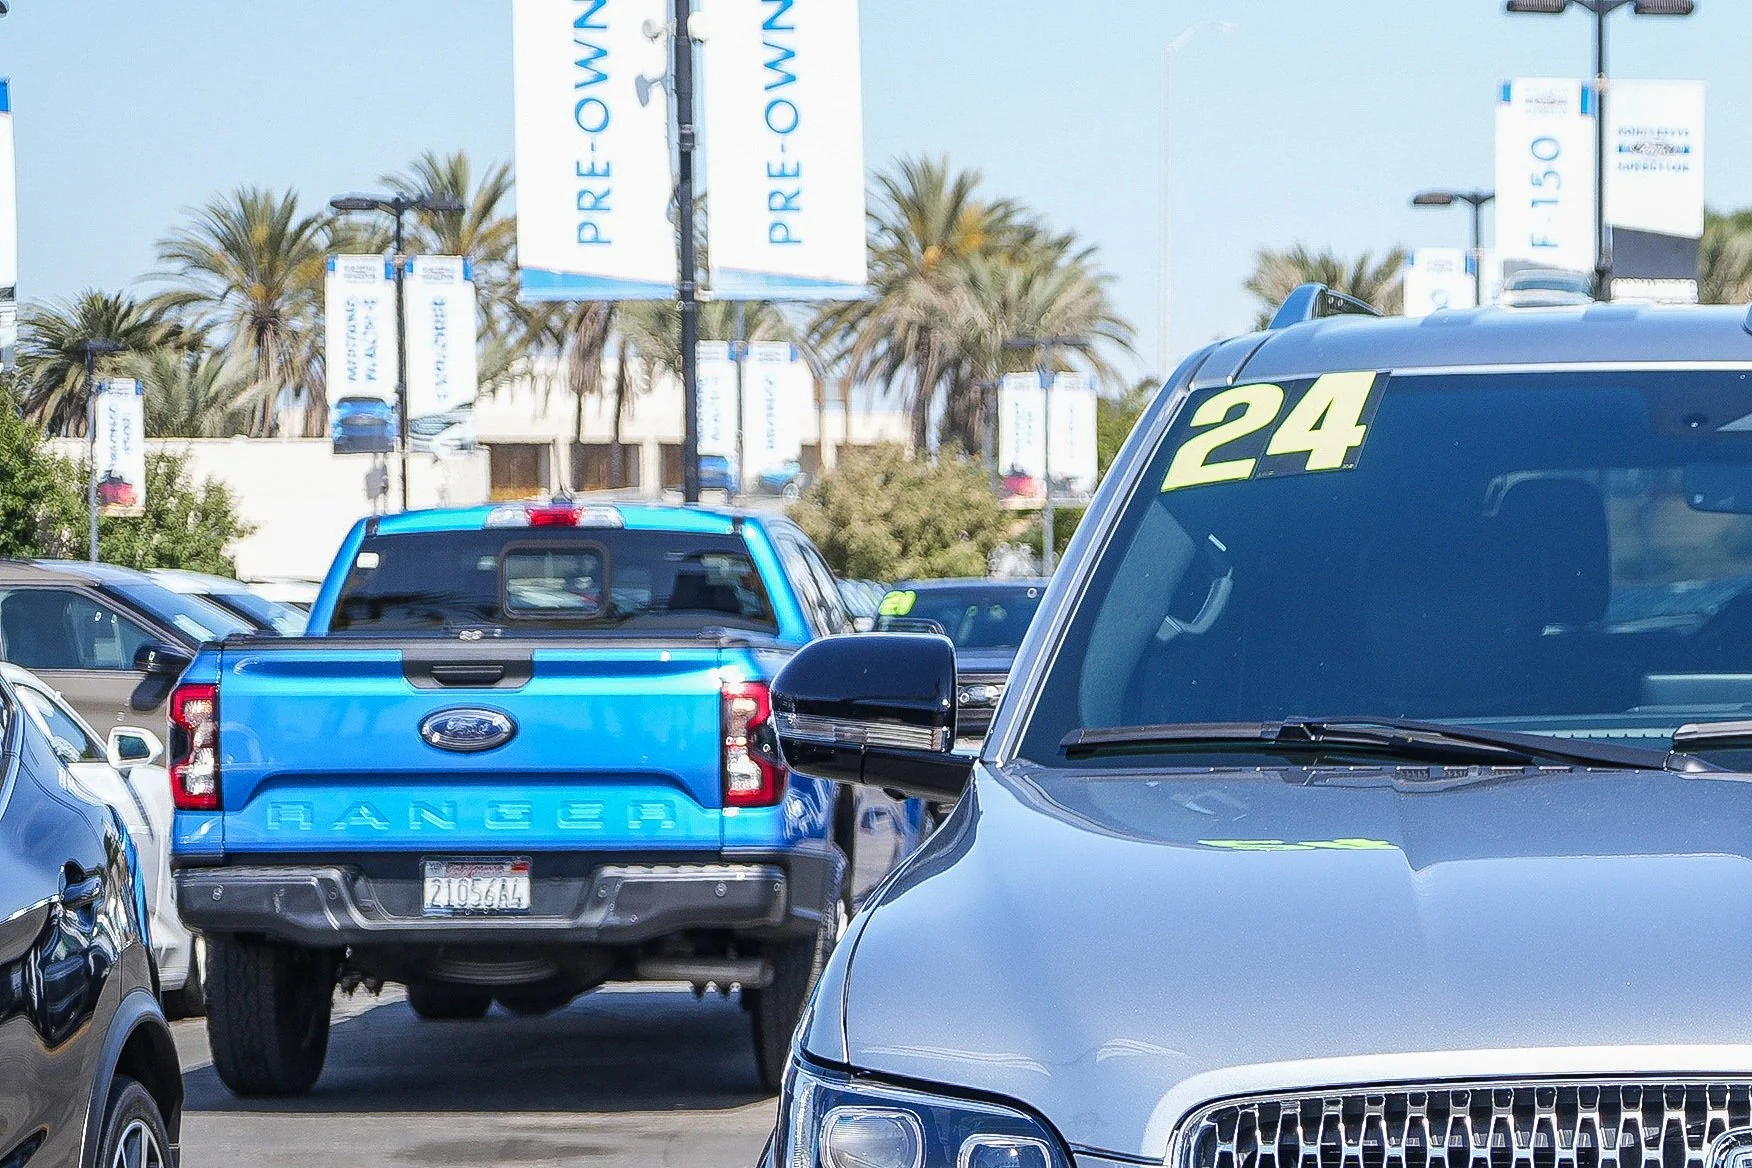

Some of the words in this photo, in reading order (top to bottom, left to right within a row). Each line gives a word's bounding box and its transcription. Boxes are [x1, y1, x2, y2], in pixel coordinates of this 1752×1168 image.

[1531, 135, 1561, 249] F-150
[1159, 370, 1368, 493] 24
[266, 801, 677, 831] RANGER
